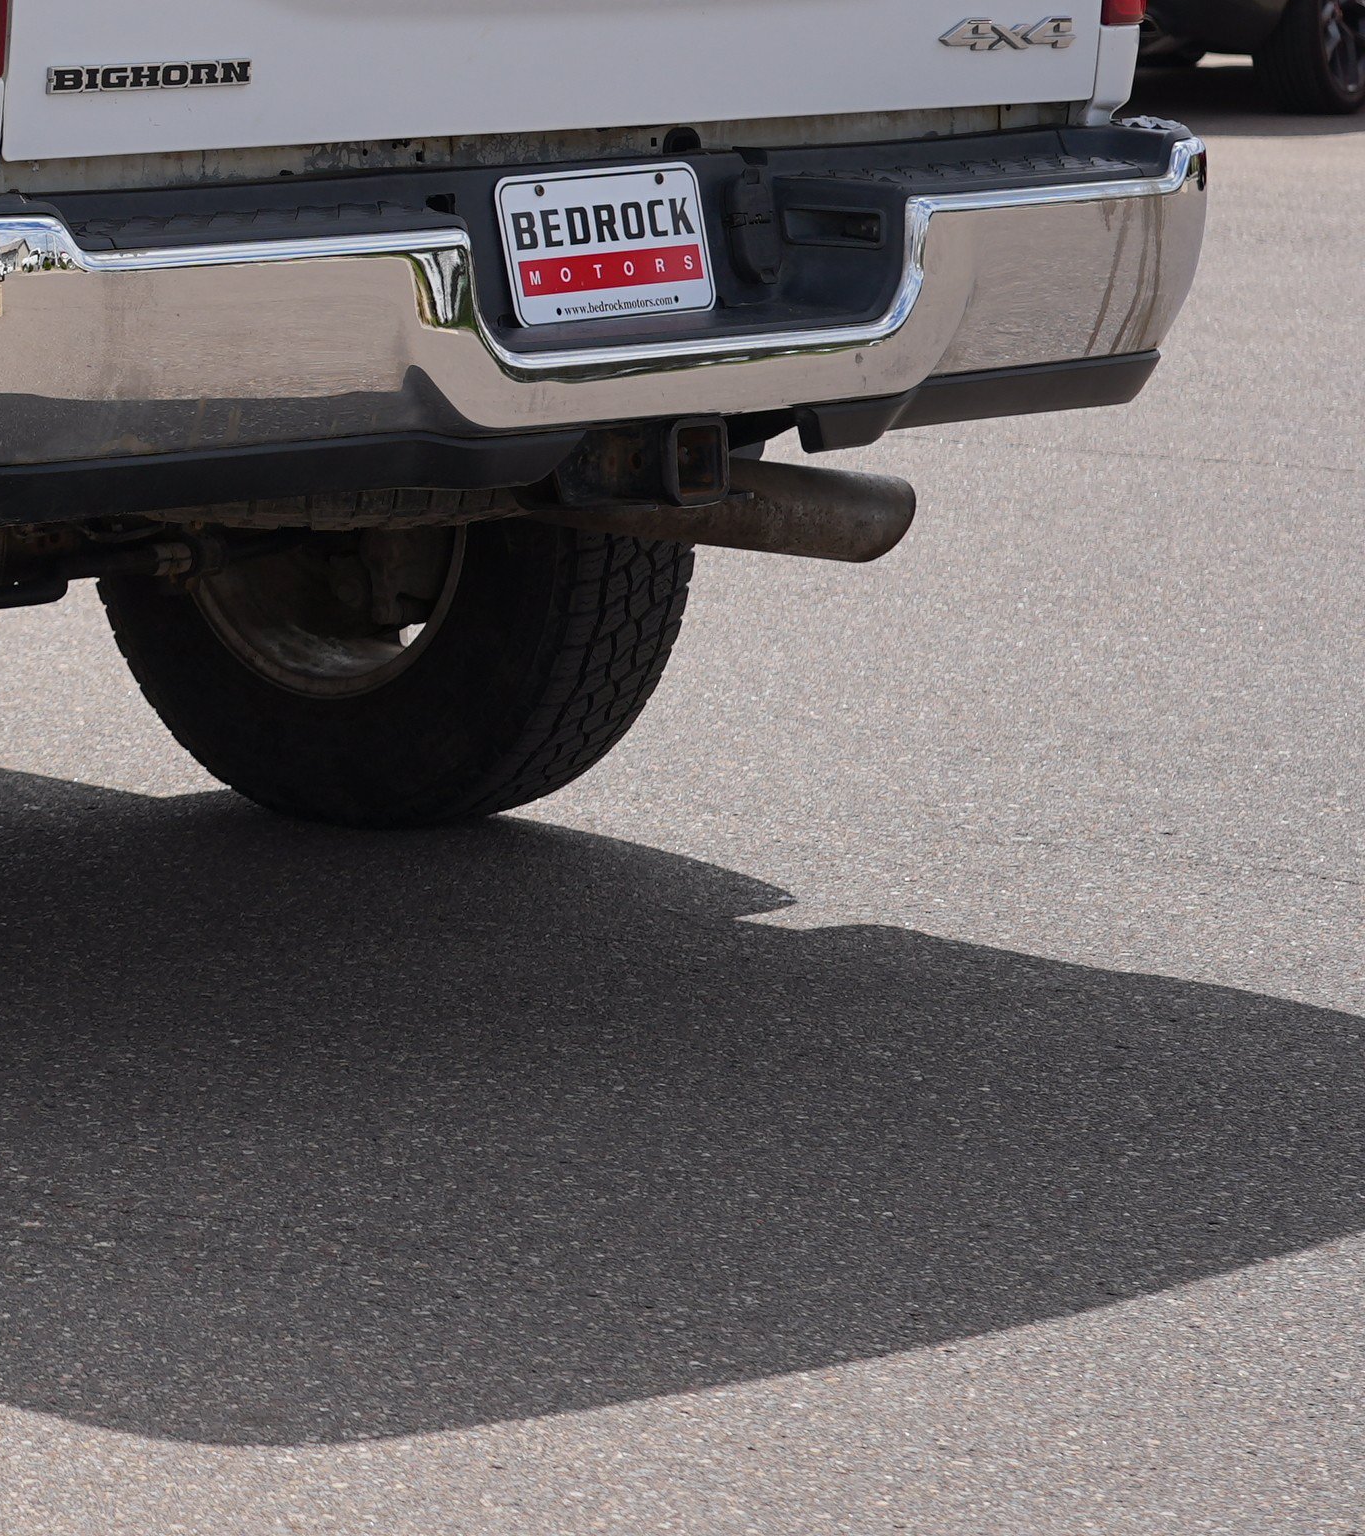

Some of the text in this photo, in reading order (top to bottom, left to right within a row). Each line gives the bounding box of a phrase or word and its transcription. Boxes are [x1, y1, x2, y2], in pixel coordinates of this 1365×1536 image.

[48, 59, 252, 94] BIGHORN
[510, 196, 696, 251] BEDROCK
[528, 254, 694, 286] MOTORS
[564, 295, 674, 316] www.bedrockmotors.com
